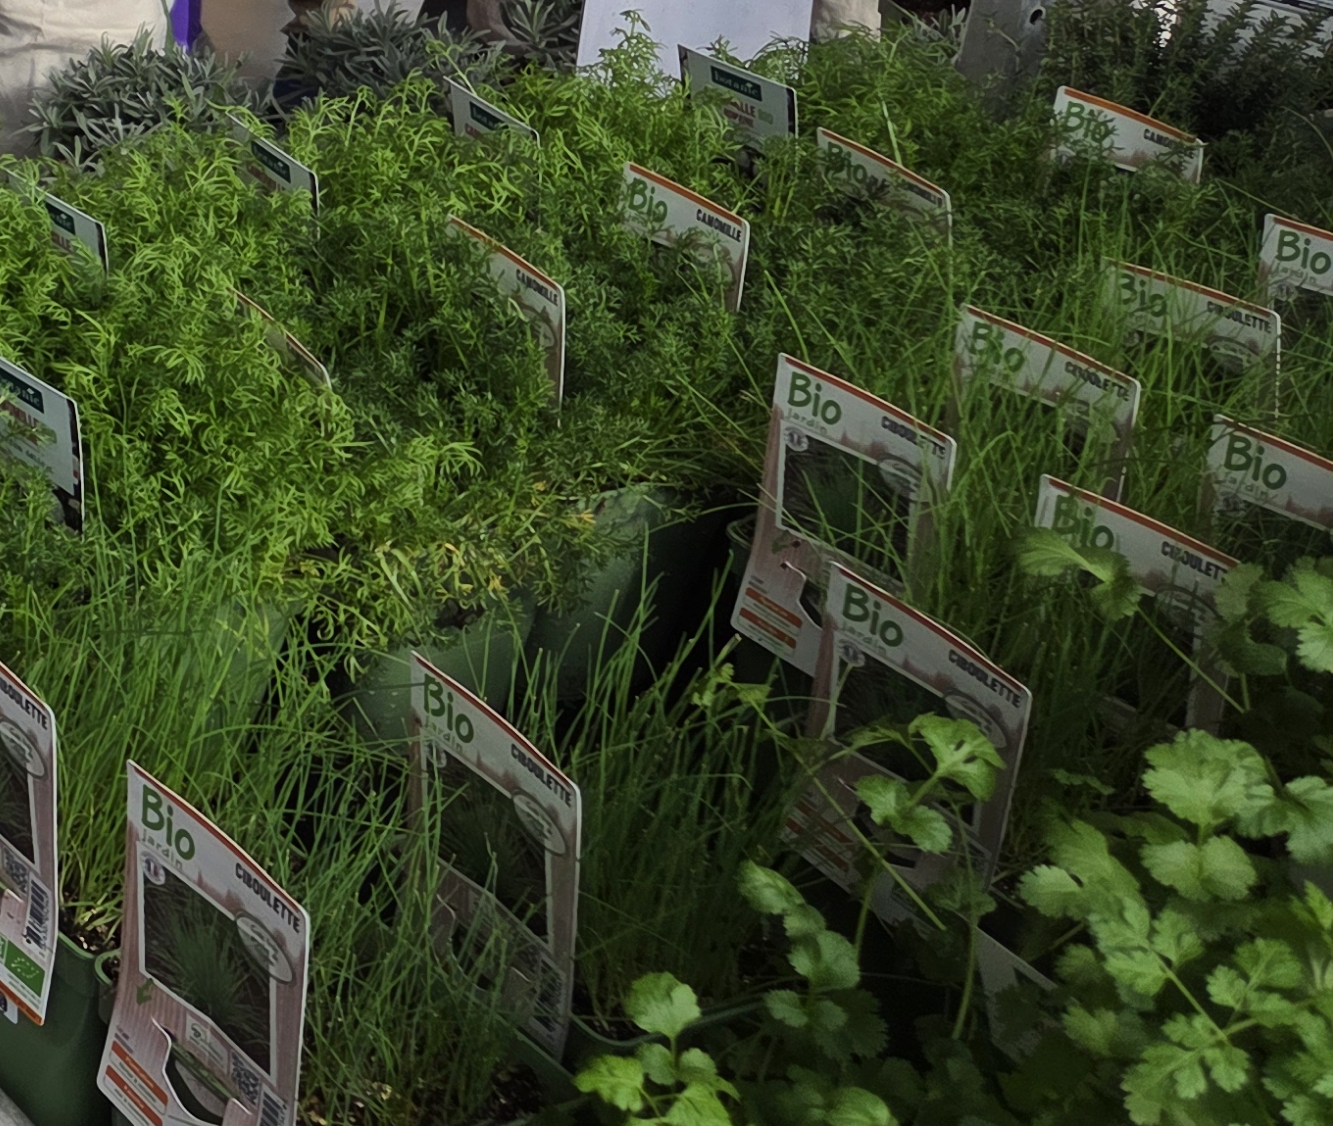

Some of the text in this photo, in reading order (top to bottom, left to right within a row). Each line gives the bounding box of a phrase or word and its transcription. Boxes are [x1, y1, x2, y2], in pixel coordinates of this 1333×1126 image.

[628, 177, 742, 243] Bio CAMOMILLE
[1275, 229, 1332, 275] Bio
[787, 371, 843, 426] Bio
[1223, 434, 1288, 491] Bio
[842, 582, 1022, 709] Bio CIBOULETTE
[424, 672, 573, 808] Bio CIBOULETTE
[141, 783, 301, 934] Bio CIBOULETTE
[142, 828, 183, 871] jardin
